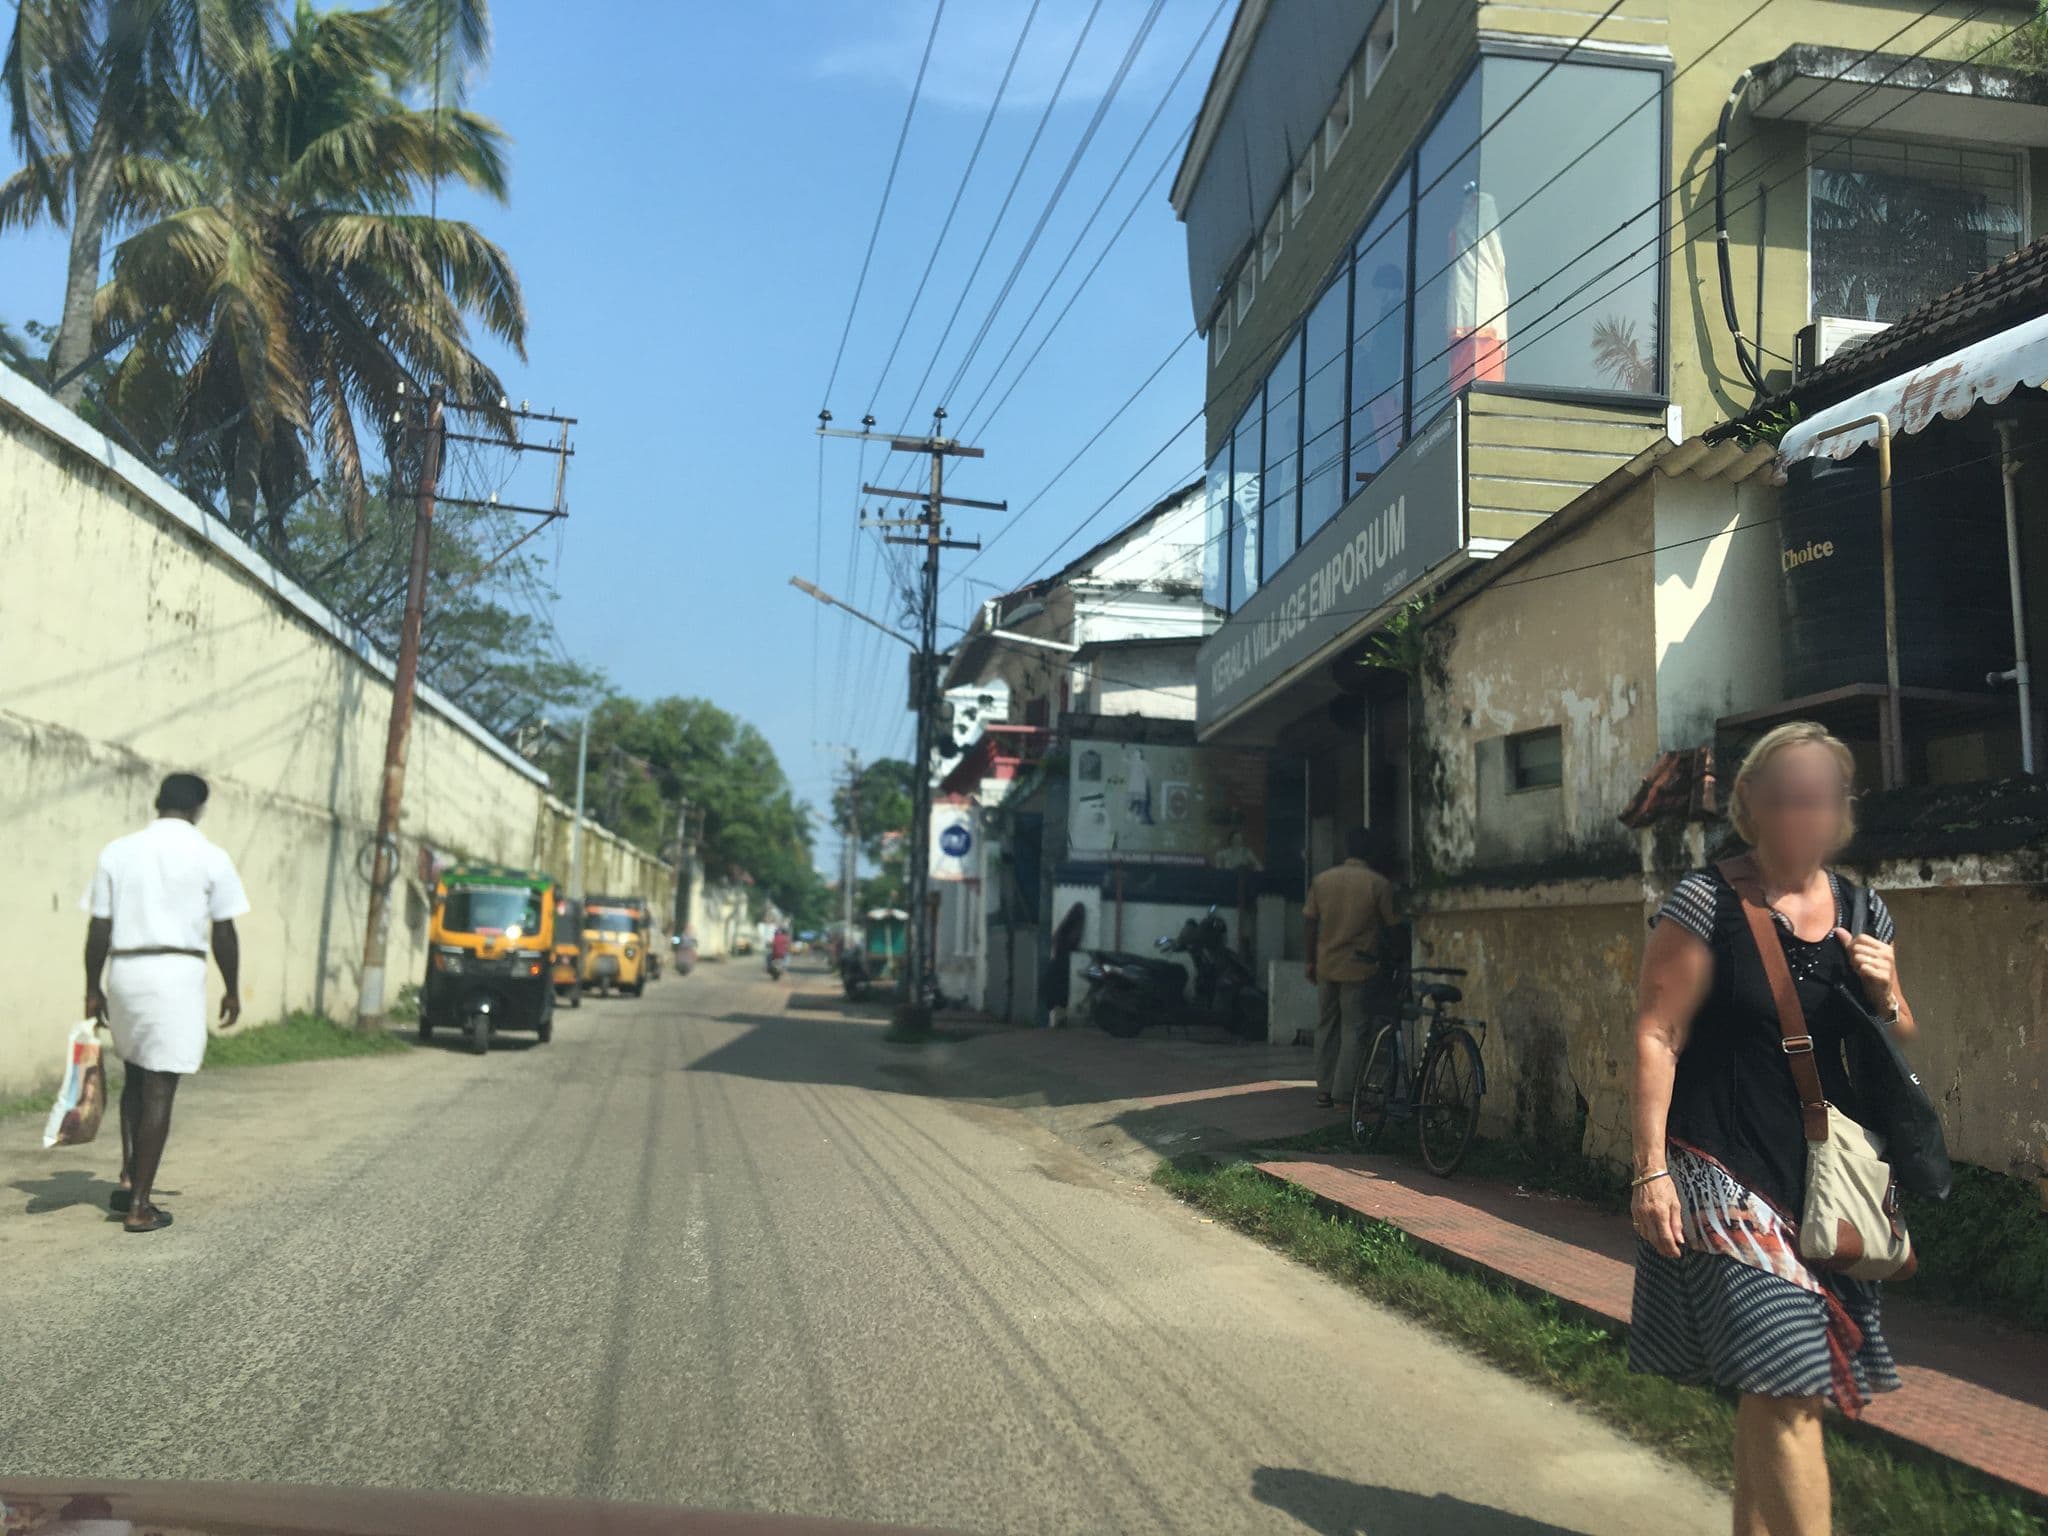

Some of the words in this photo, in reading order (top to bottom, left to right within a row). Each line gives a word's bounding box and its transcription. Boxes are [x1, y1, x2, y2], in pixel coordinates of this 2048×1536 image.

[1211, 634, 1251, 697] KERALA
[1252, 582, 1306, 665] VILLAGE
[1309, 494, 1405, 622] EMPORIUM
[1781, 540, 1834, 573] Choice
